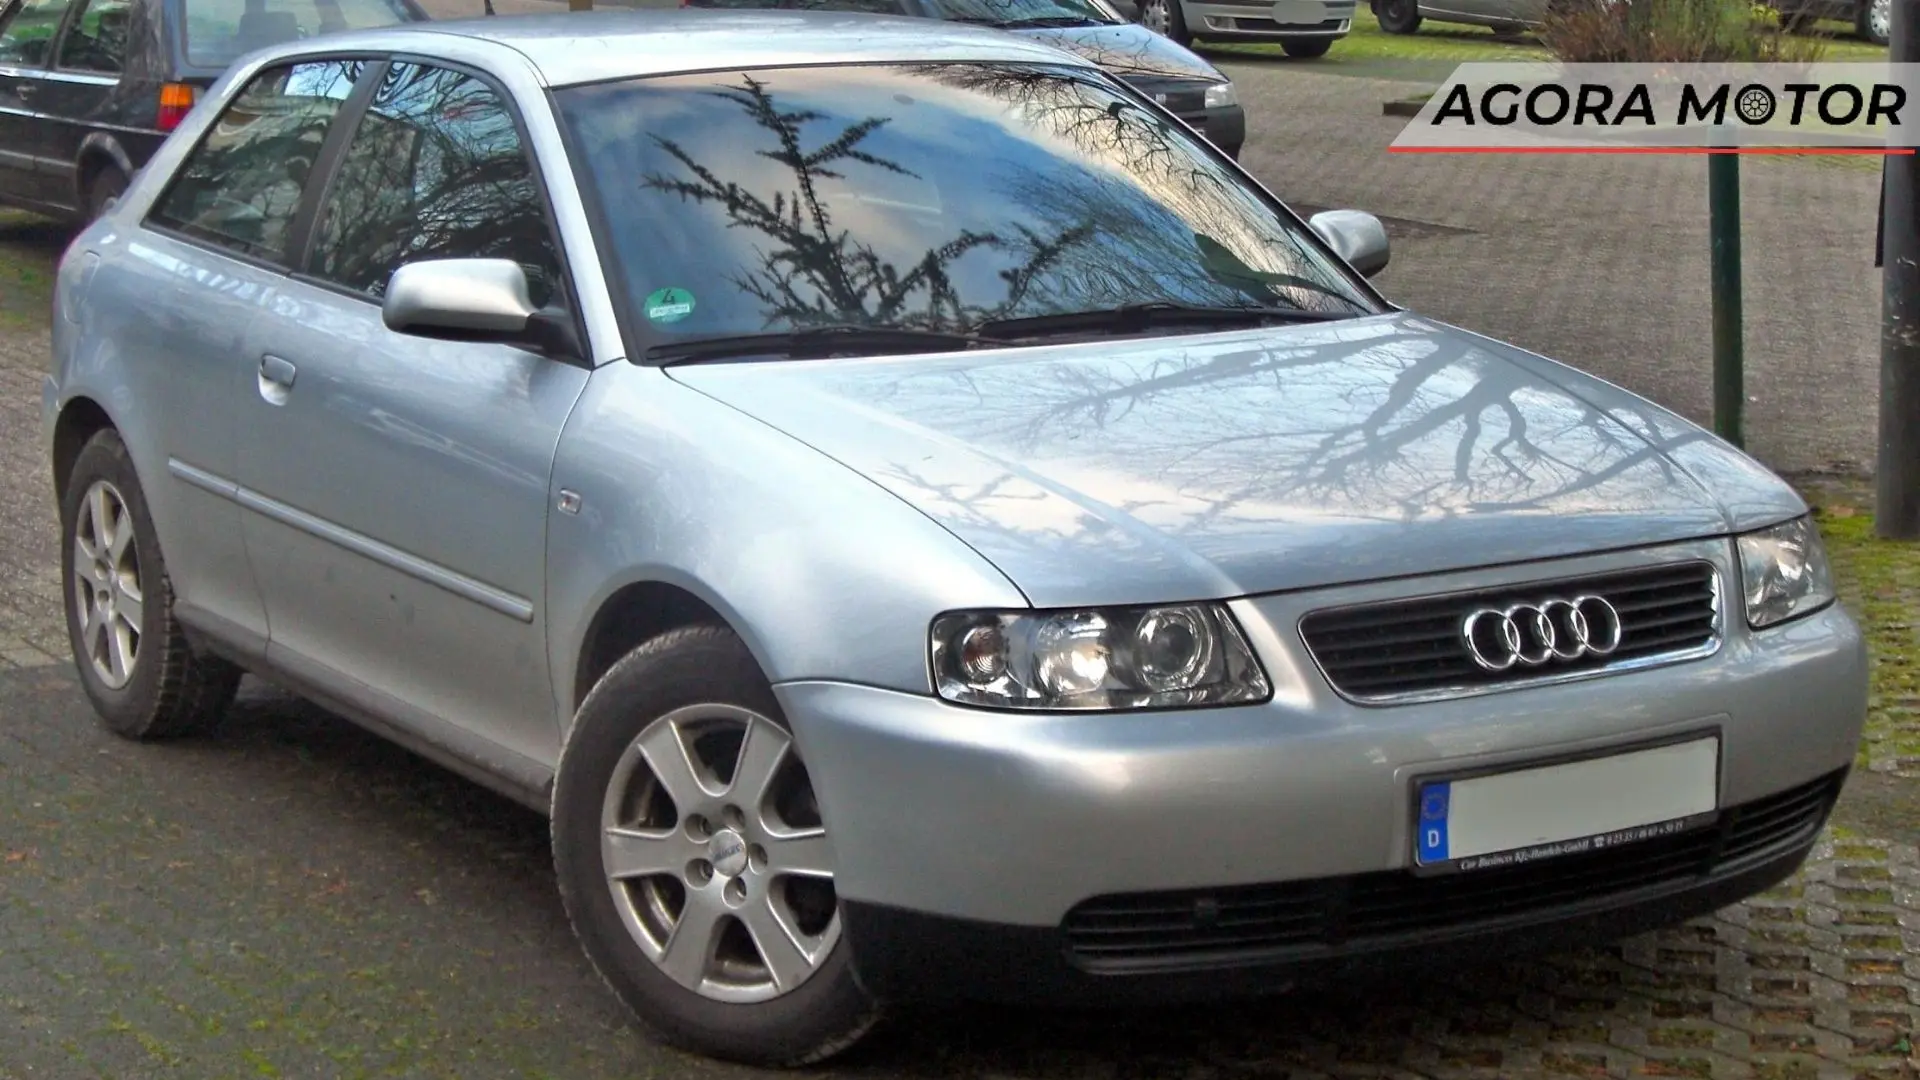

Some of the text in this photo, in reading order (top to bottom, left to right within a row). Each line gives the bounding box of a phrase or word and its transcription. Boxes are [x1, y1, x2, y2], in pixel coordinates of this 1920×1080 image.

[662, 289, 676, 305] 4
[1428, 830, 1440, 848] D
[1460, 860, 1476, 870] Car
[1478, 854, 1513, 868] Business
